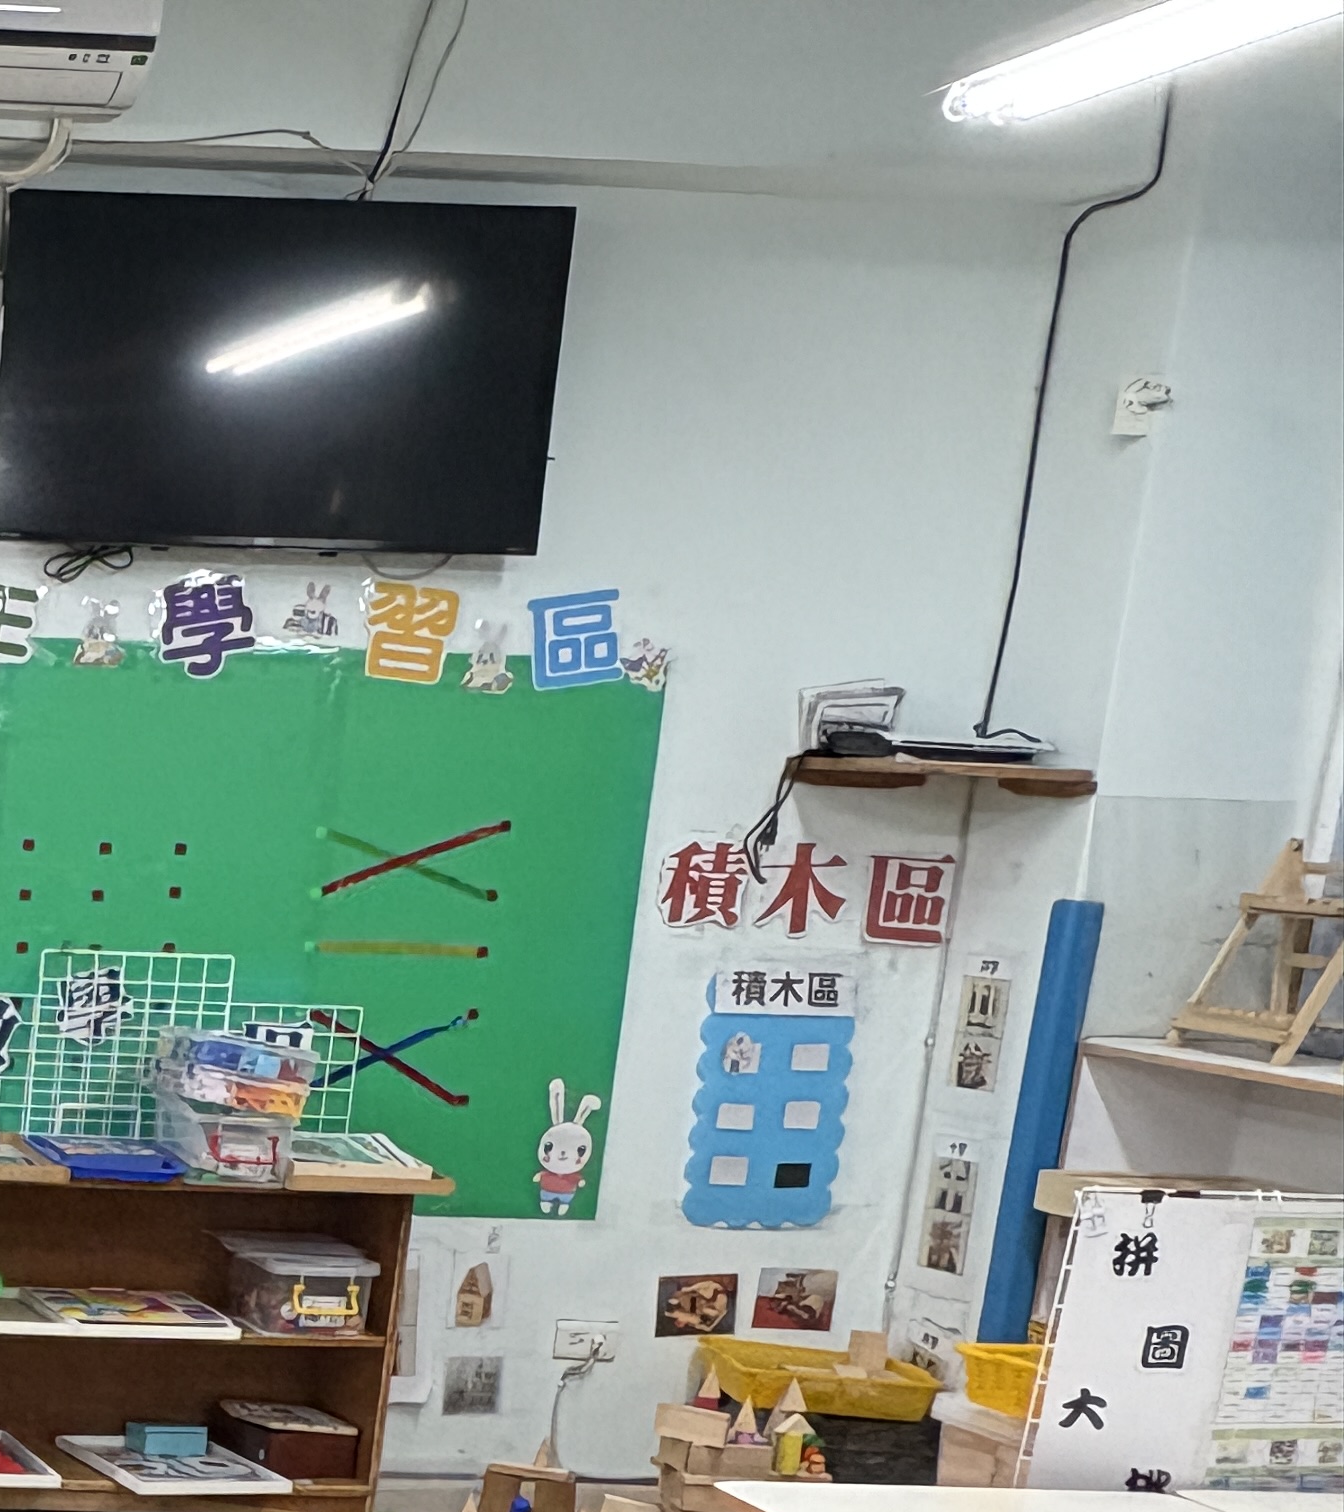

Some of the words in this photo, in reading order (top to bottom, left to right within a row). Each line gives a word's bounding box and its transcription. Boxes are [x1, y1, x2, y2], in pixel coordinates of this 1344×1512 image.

[661, 841, 956, 944] 積木區
[731, 970, 844, 1008] 積木區
